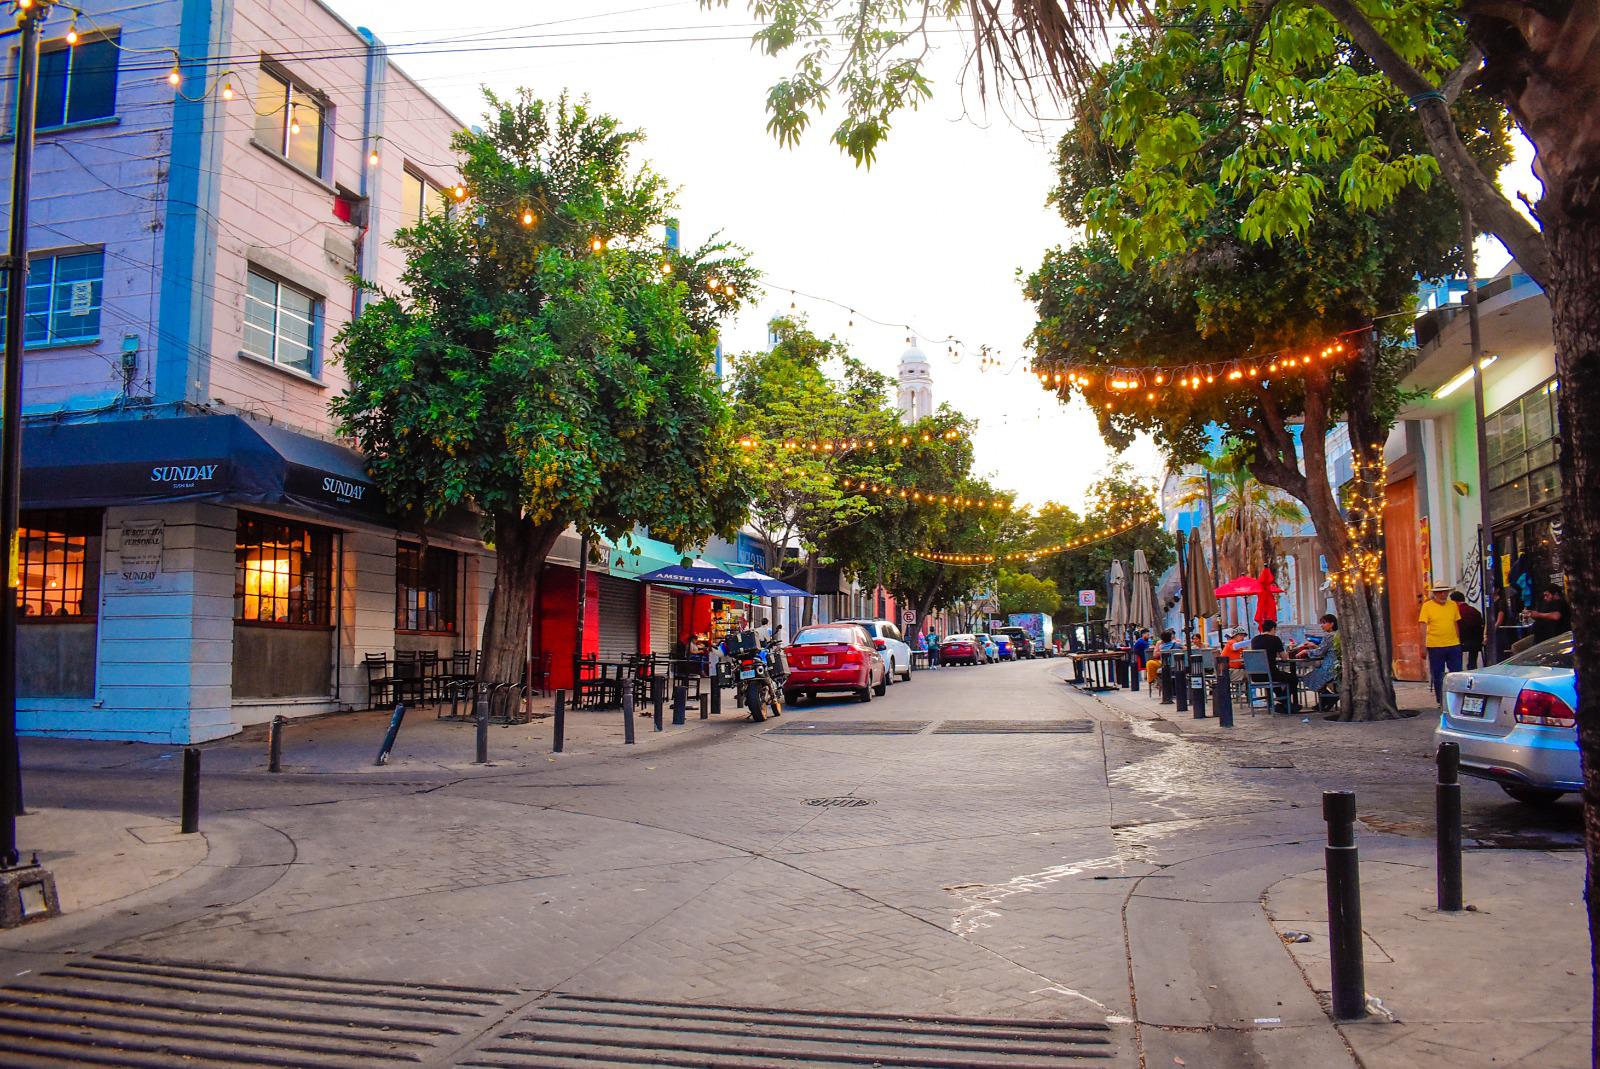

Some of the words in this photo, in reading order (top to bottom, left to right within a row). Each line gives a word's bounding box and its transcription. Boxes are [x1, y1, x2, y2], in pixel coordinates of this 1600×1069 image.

[151, 465, 218, 481] SUNDAY
[322, 477, 365, 499] SUNDAY
[122, 572, 156, 580] SUNDAY
[655, 573, 696, 582] AMSTEL
[698, 577, 734, 585] ULTRA
